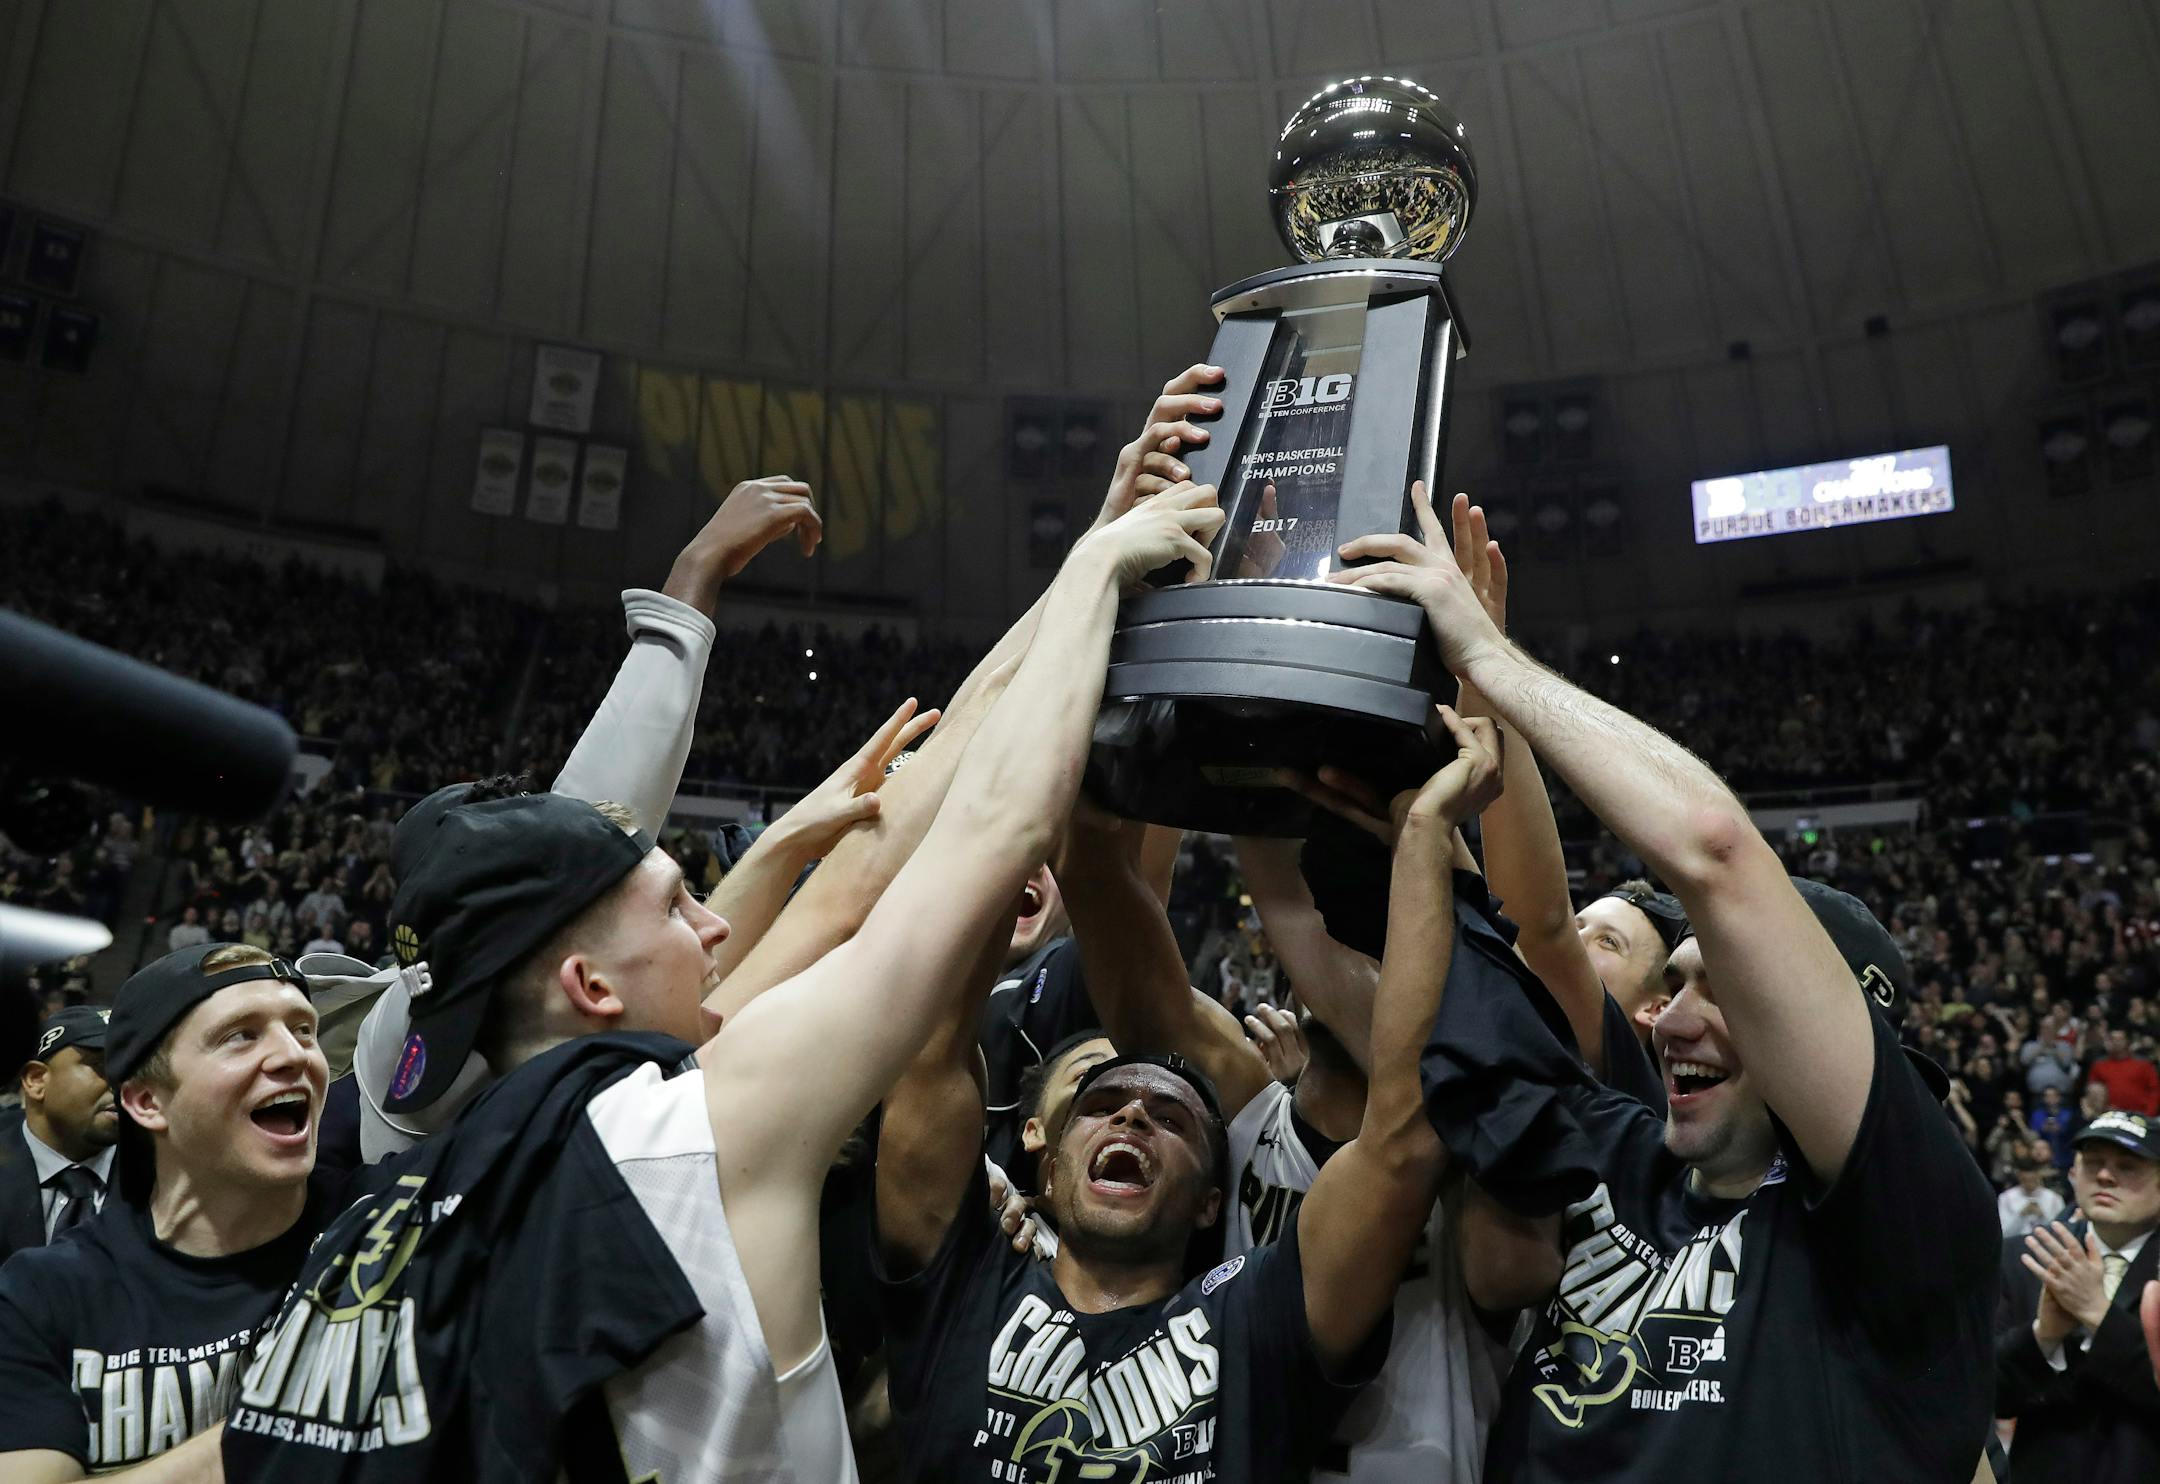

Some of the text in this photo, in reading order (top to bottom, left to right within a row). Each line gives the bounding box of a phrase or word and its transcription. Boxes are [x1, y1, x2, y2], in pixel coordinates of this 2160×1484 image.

[1258, 404, 1346, 419] BG TEN CONFERENCE
[1241, 446, 1344, 465] MEN'S BASKETBALL
[1241, 462, 1337, 480] CHAMPIONS
[1251, 518, 1299, 533] 2017
[1610, 1222, 1635, 1250] BIG
[107, 1348, 140, 1370] BIG
